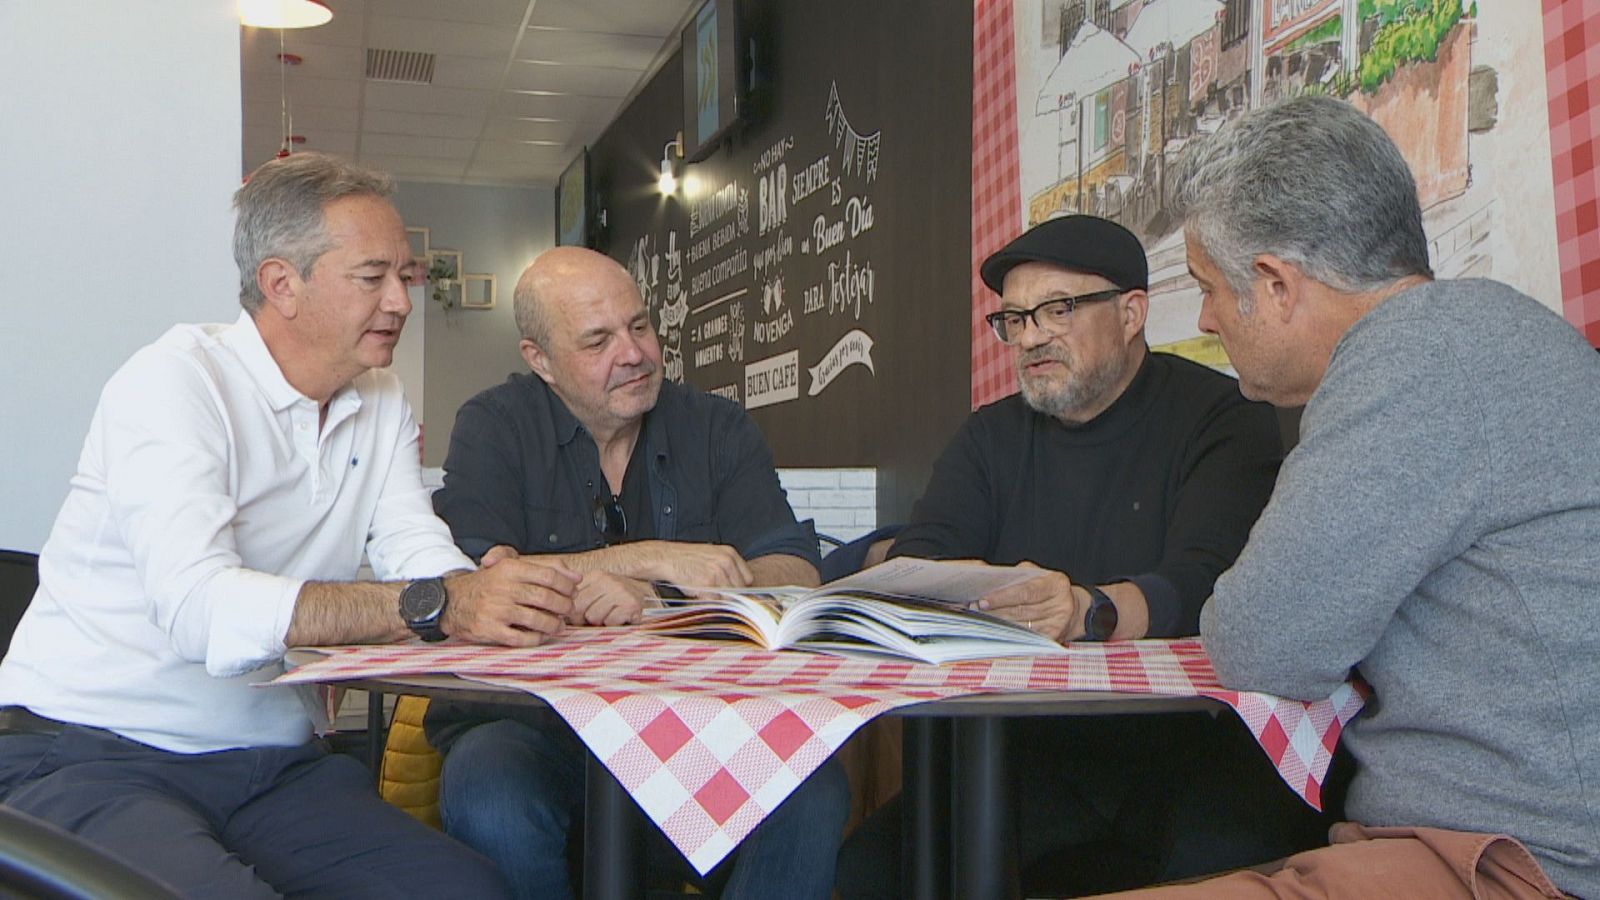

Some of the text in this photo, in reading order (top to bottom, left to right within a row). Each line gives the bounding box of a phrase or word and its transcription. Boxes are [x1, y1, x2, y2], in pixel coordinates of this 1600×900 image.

[771, 137, 785, 164] HAY
[759, 163, 787, 236] BAR
[792, 155, 830, 206] SIEMPRE
[832, 176, 841, 206] ES
[691, 236, 711, 264] BUENA
[713, 222, 736, 251] BEBIDA
[813, 215, 845, 256] Buen
[846, 195, 875, 239] Día
[804, 283, 824, 315] PARA
[754, 308, 793, 343] NO VENGA
[747, 356, 796, 397] BUEN CAFÉ
